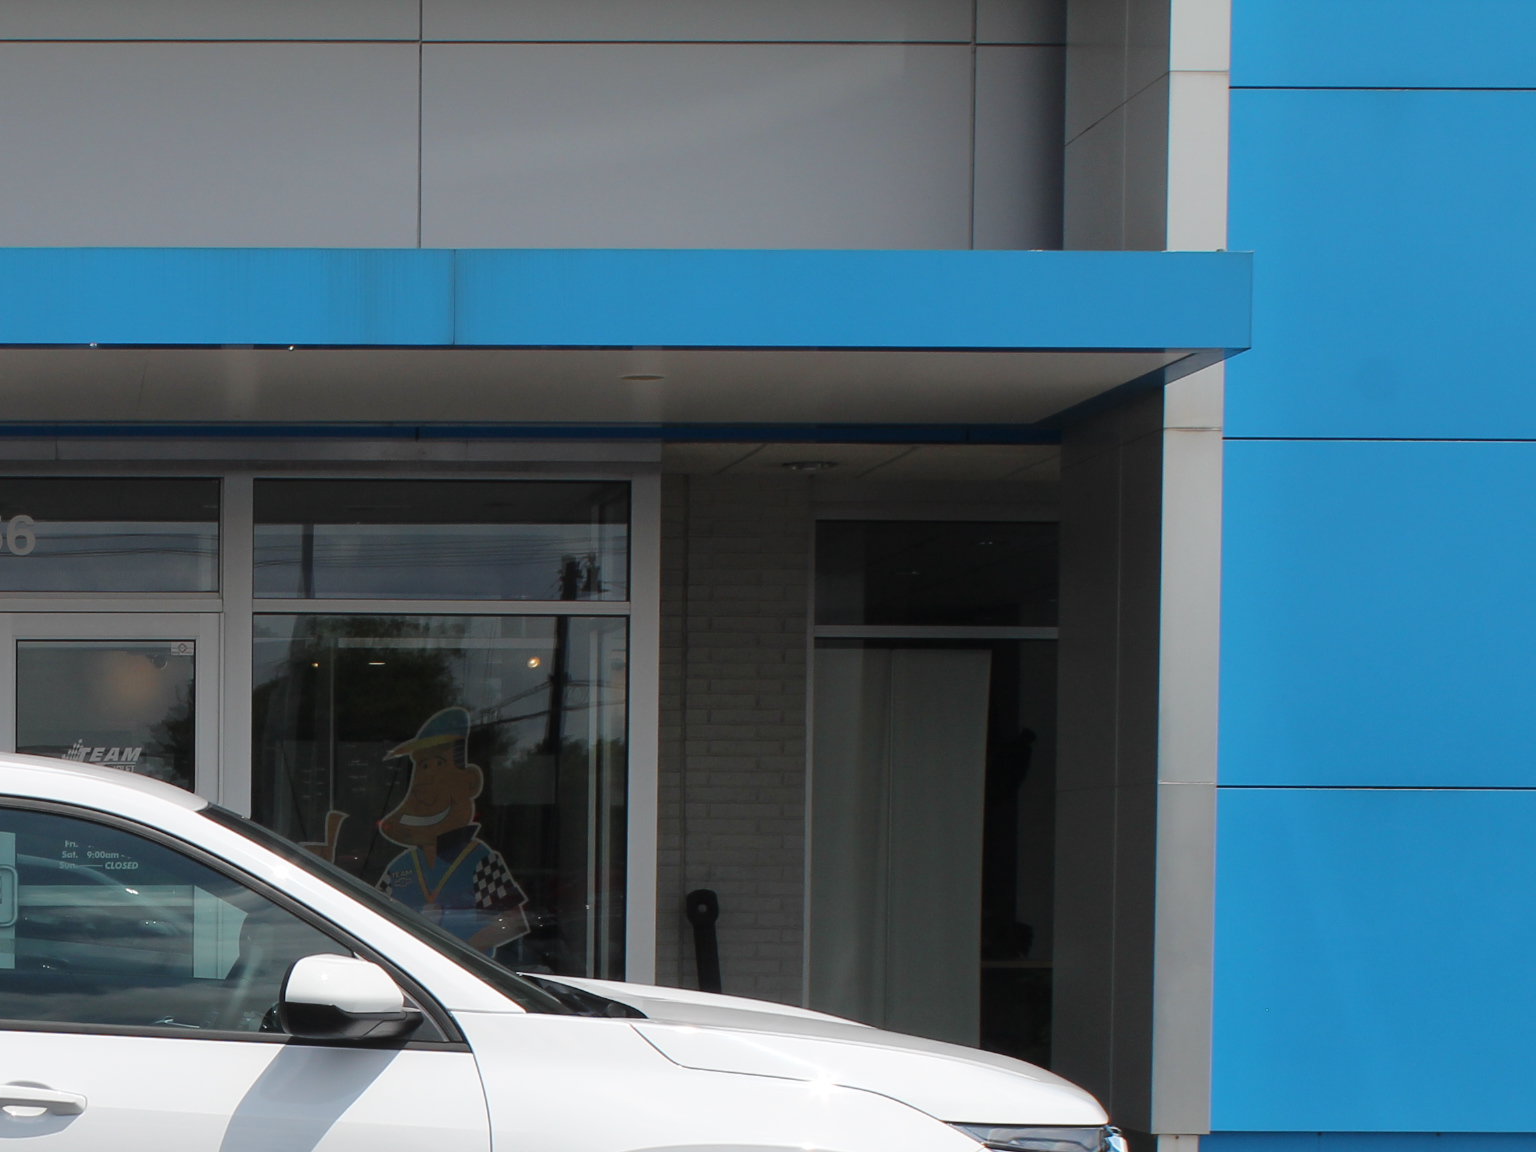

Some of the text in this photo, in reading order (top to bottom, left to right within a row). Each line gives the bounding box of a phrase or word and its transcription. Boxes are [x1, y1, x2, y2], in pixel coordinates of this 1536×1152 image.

[78, 747, 142, 762] TEAM
[62, 851, 120, 859] Sat. 9:00am
[105, 861, 139, 870] CLOSED
